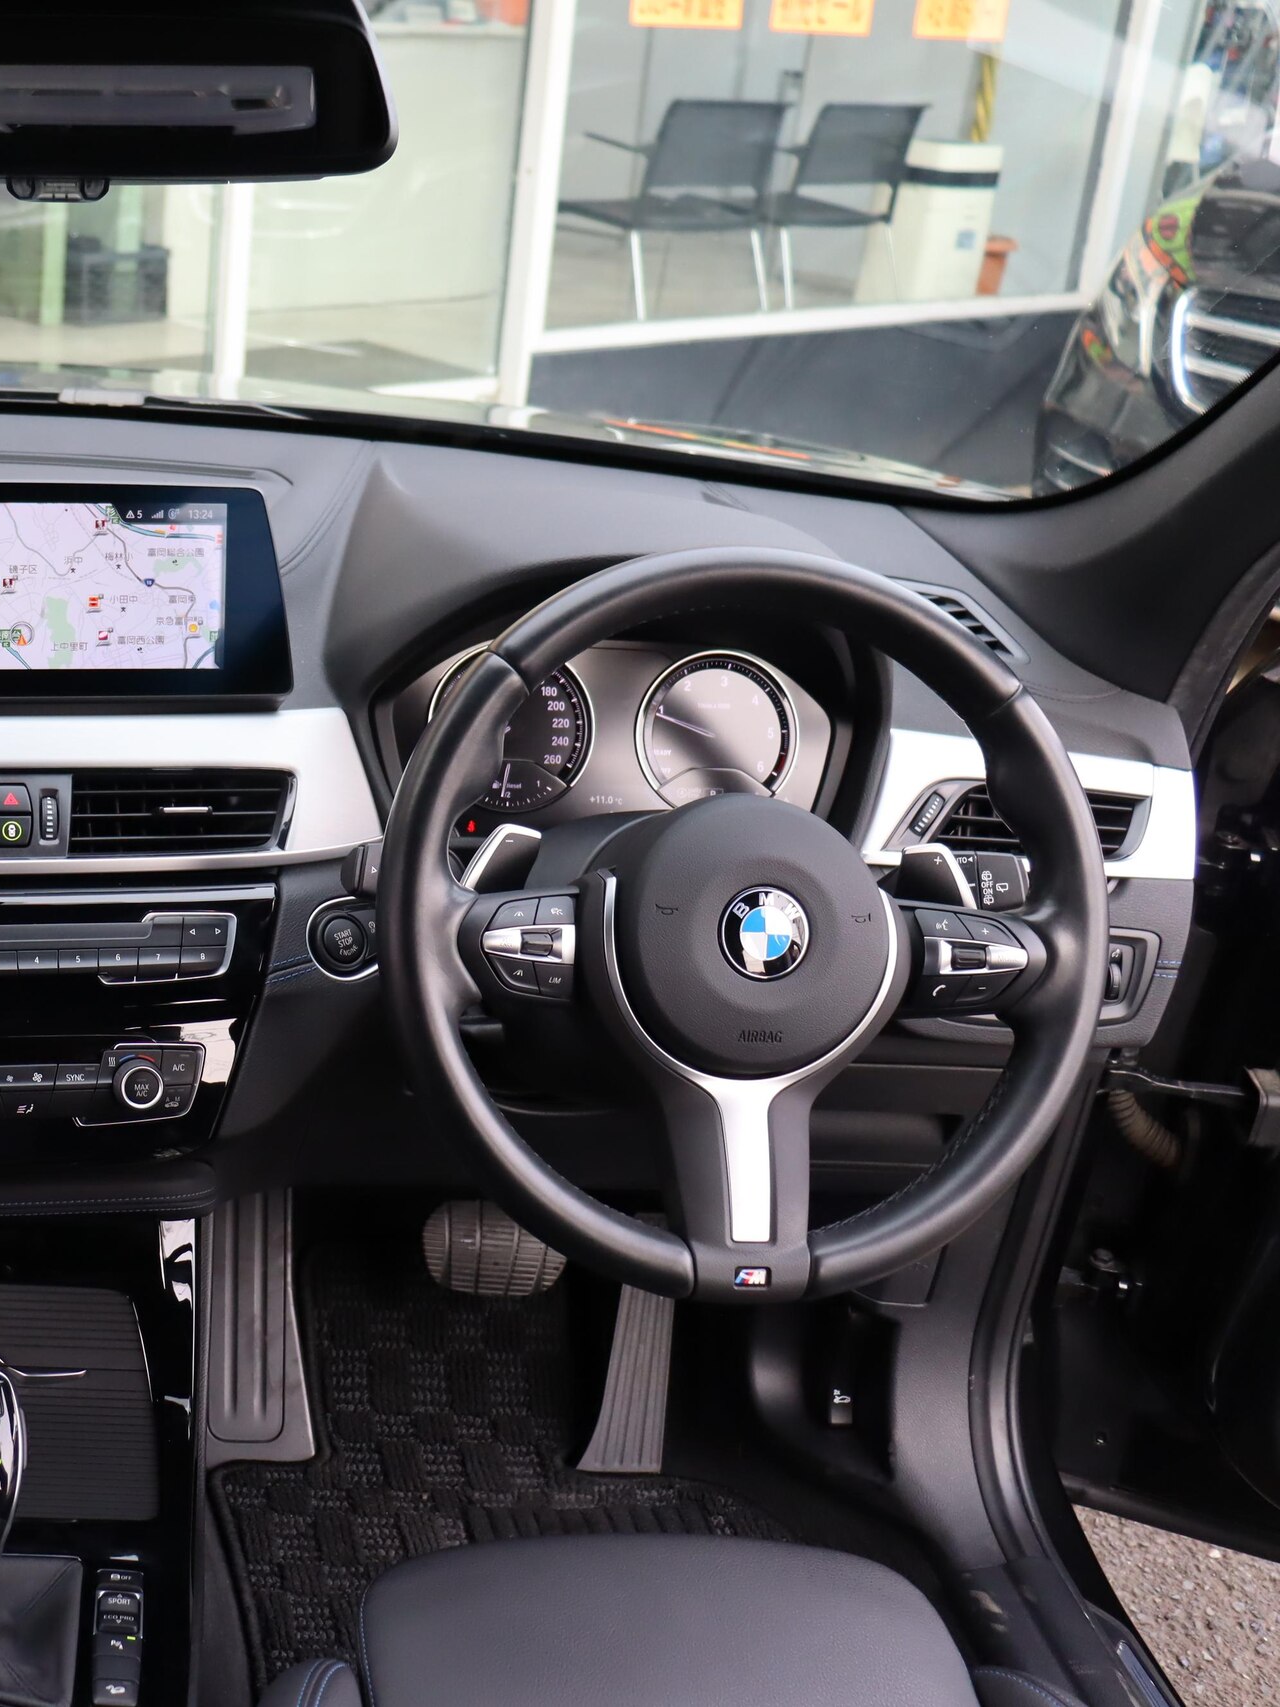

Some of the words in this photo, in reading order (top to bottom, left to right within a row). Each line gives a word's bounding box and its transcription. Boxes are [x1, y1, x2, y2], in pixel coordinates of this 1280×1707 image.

[136, 510, 143, 518] 5
[188, 510, 213, 518] 13:24
[684, 681, 691, 691] 2
[721, 676, 728, 686] 3
[541, 686, 558, 696] 180
[752, 696, 759, 705] 4
[548, 701, 565, 711] 200
[658, 706, 664, 714] 1
[552, 718, 570, 728] 220
[768, 728, 774, 738] 5
[552, 736, 568, 746] 240
[544, 755, 562, 764] 260
[757, 762, 764, 772] 6
[732, 892, 802, 922] BMW
[334, 928, 352, 940] START
[338, 936, 353, 948] STOP
[340, 944, 358, 956] ENGINE
[738, 1030, 783, 1043] AIRBAG
[66, 1074, 85, 1082] SYNC
